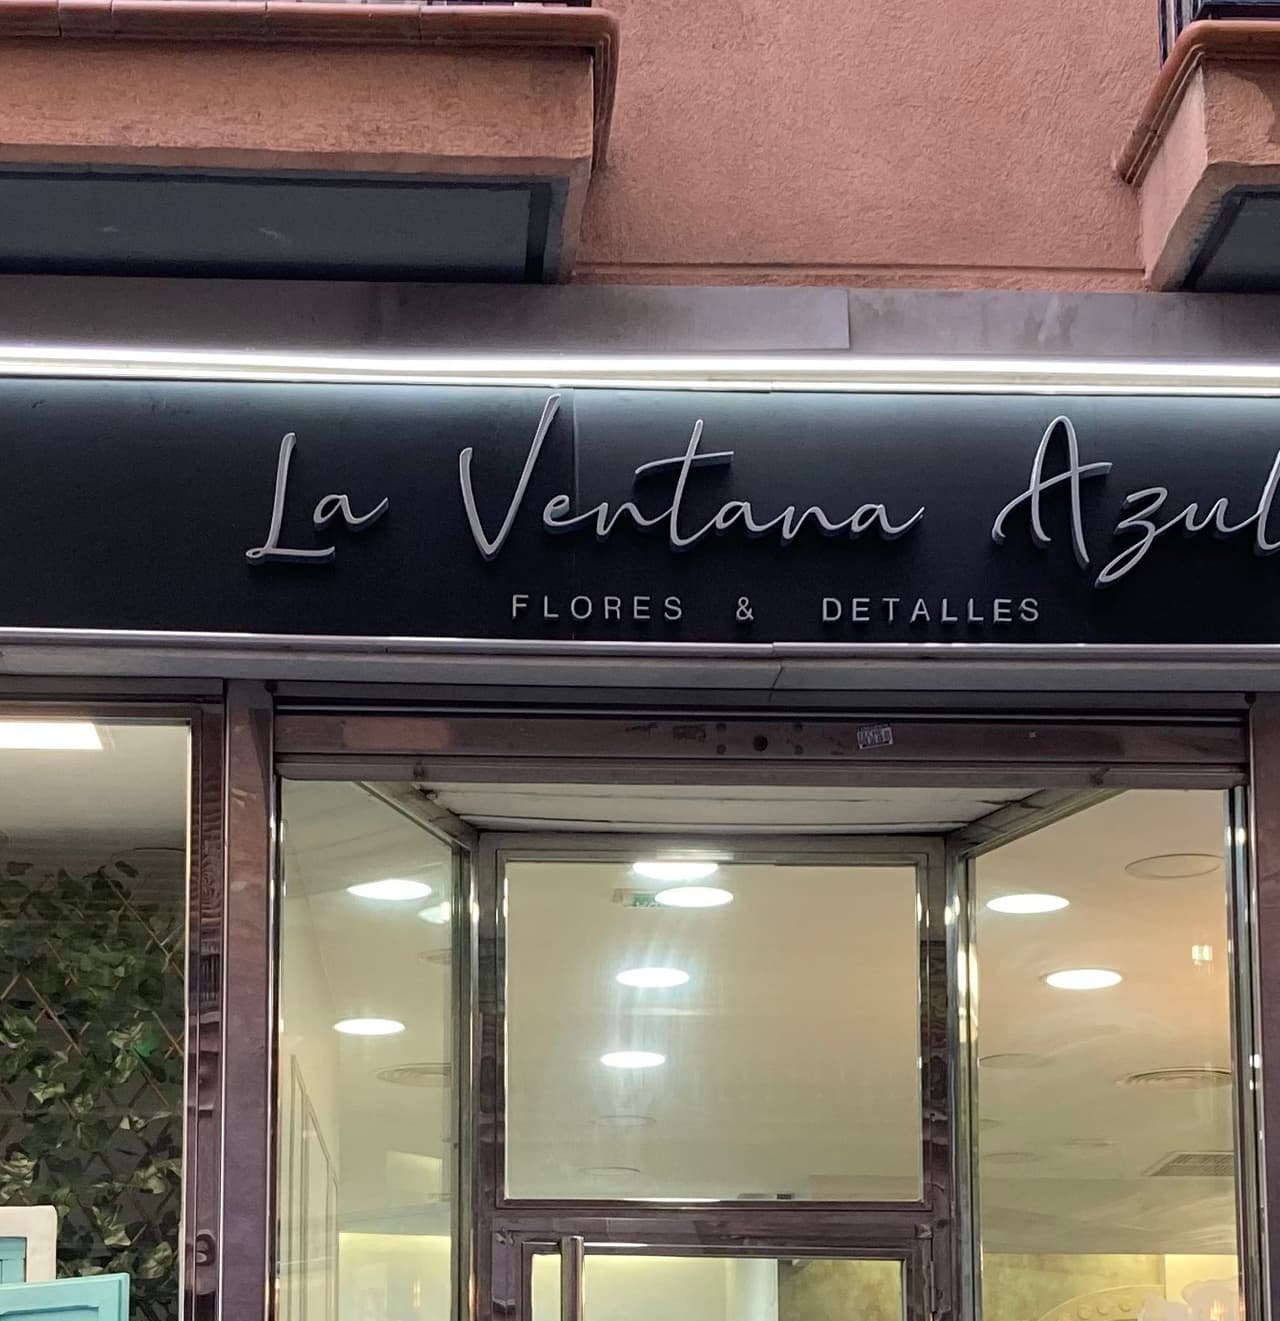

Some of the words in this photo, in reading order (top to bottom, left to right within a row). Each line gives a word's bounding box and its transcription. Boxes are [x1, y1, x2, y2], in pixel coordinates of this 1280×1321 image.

[245, 431, 389, 564] La
[459, 393, 925, 563] Ventana
[512, 594, 686, 624] FLORES
[735, 598, 756, 624] &
[821, 597, 1043, 626] DETALLES
